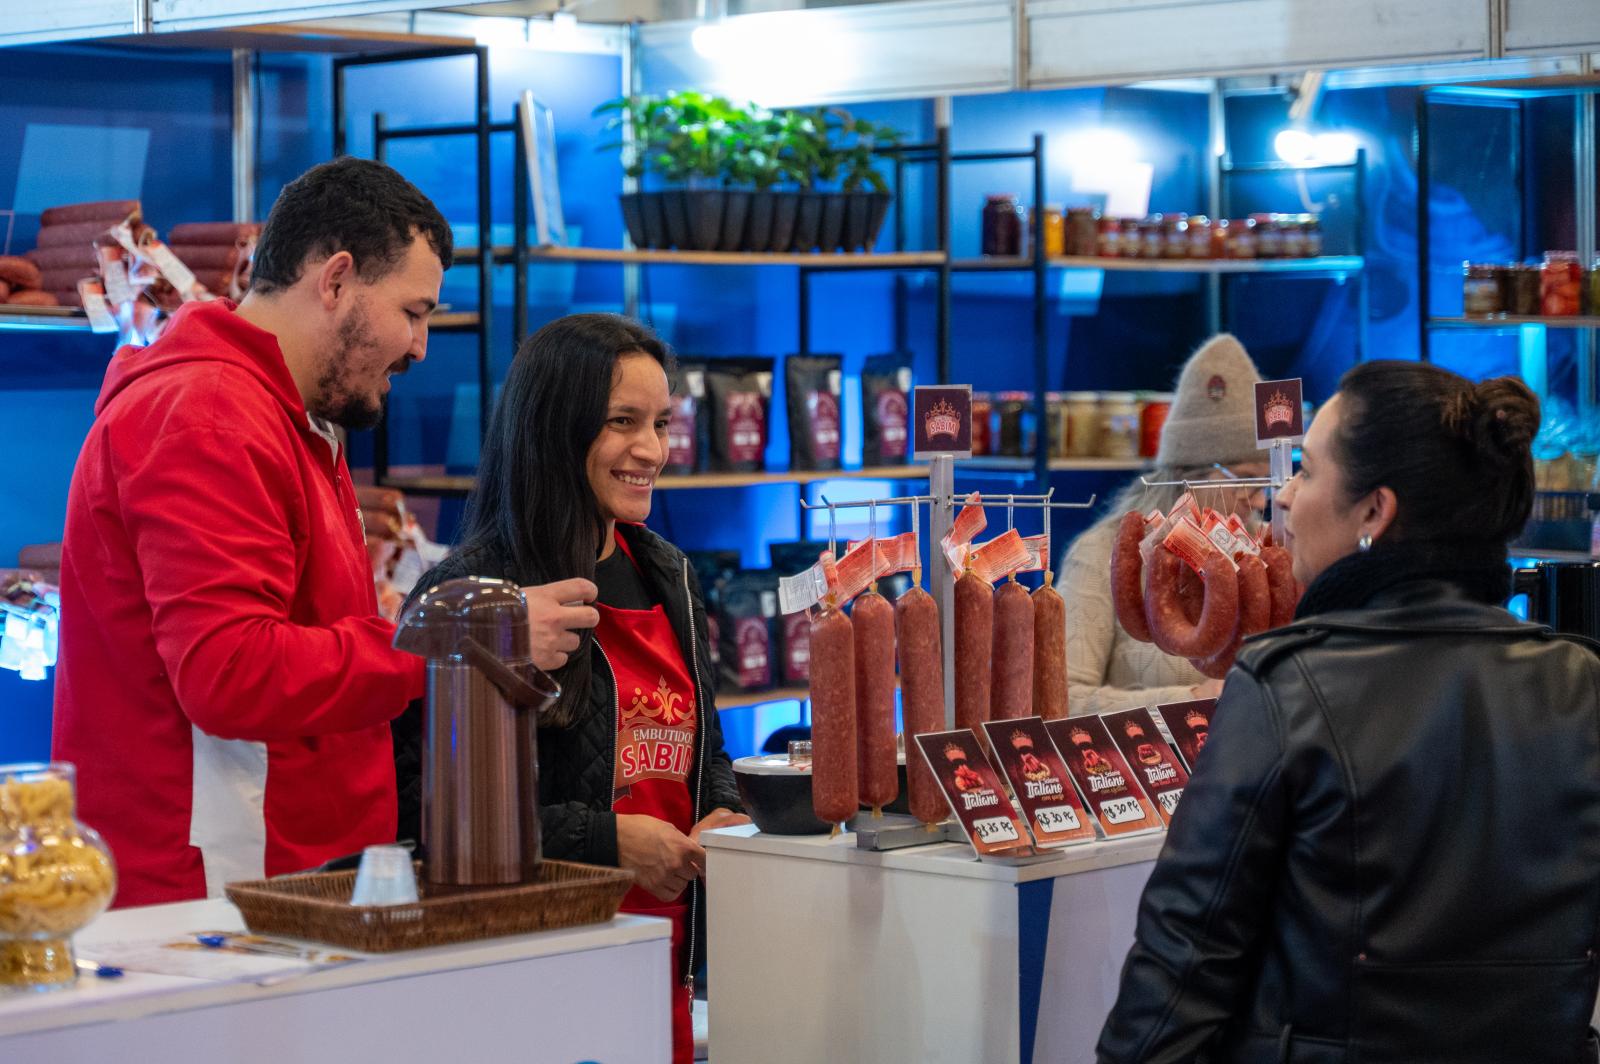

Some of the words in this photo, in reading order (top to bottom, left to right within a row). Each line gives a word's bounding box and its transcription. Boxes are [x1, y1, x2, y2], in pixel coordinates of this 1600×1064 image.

[930, 419, 957, 435] SABIM
[1087, 774, 1125, 792] Italiano
[1143, 766, 1177, 784] Italiano
[1024, 780, 1063, 799] Italiano
[960, 792, 999, 810] Italiano
[1113, 803, 1127, 815] 30
[1050, 811, 1063, 823] 30
